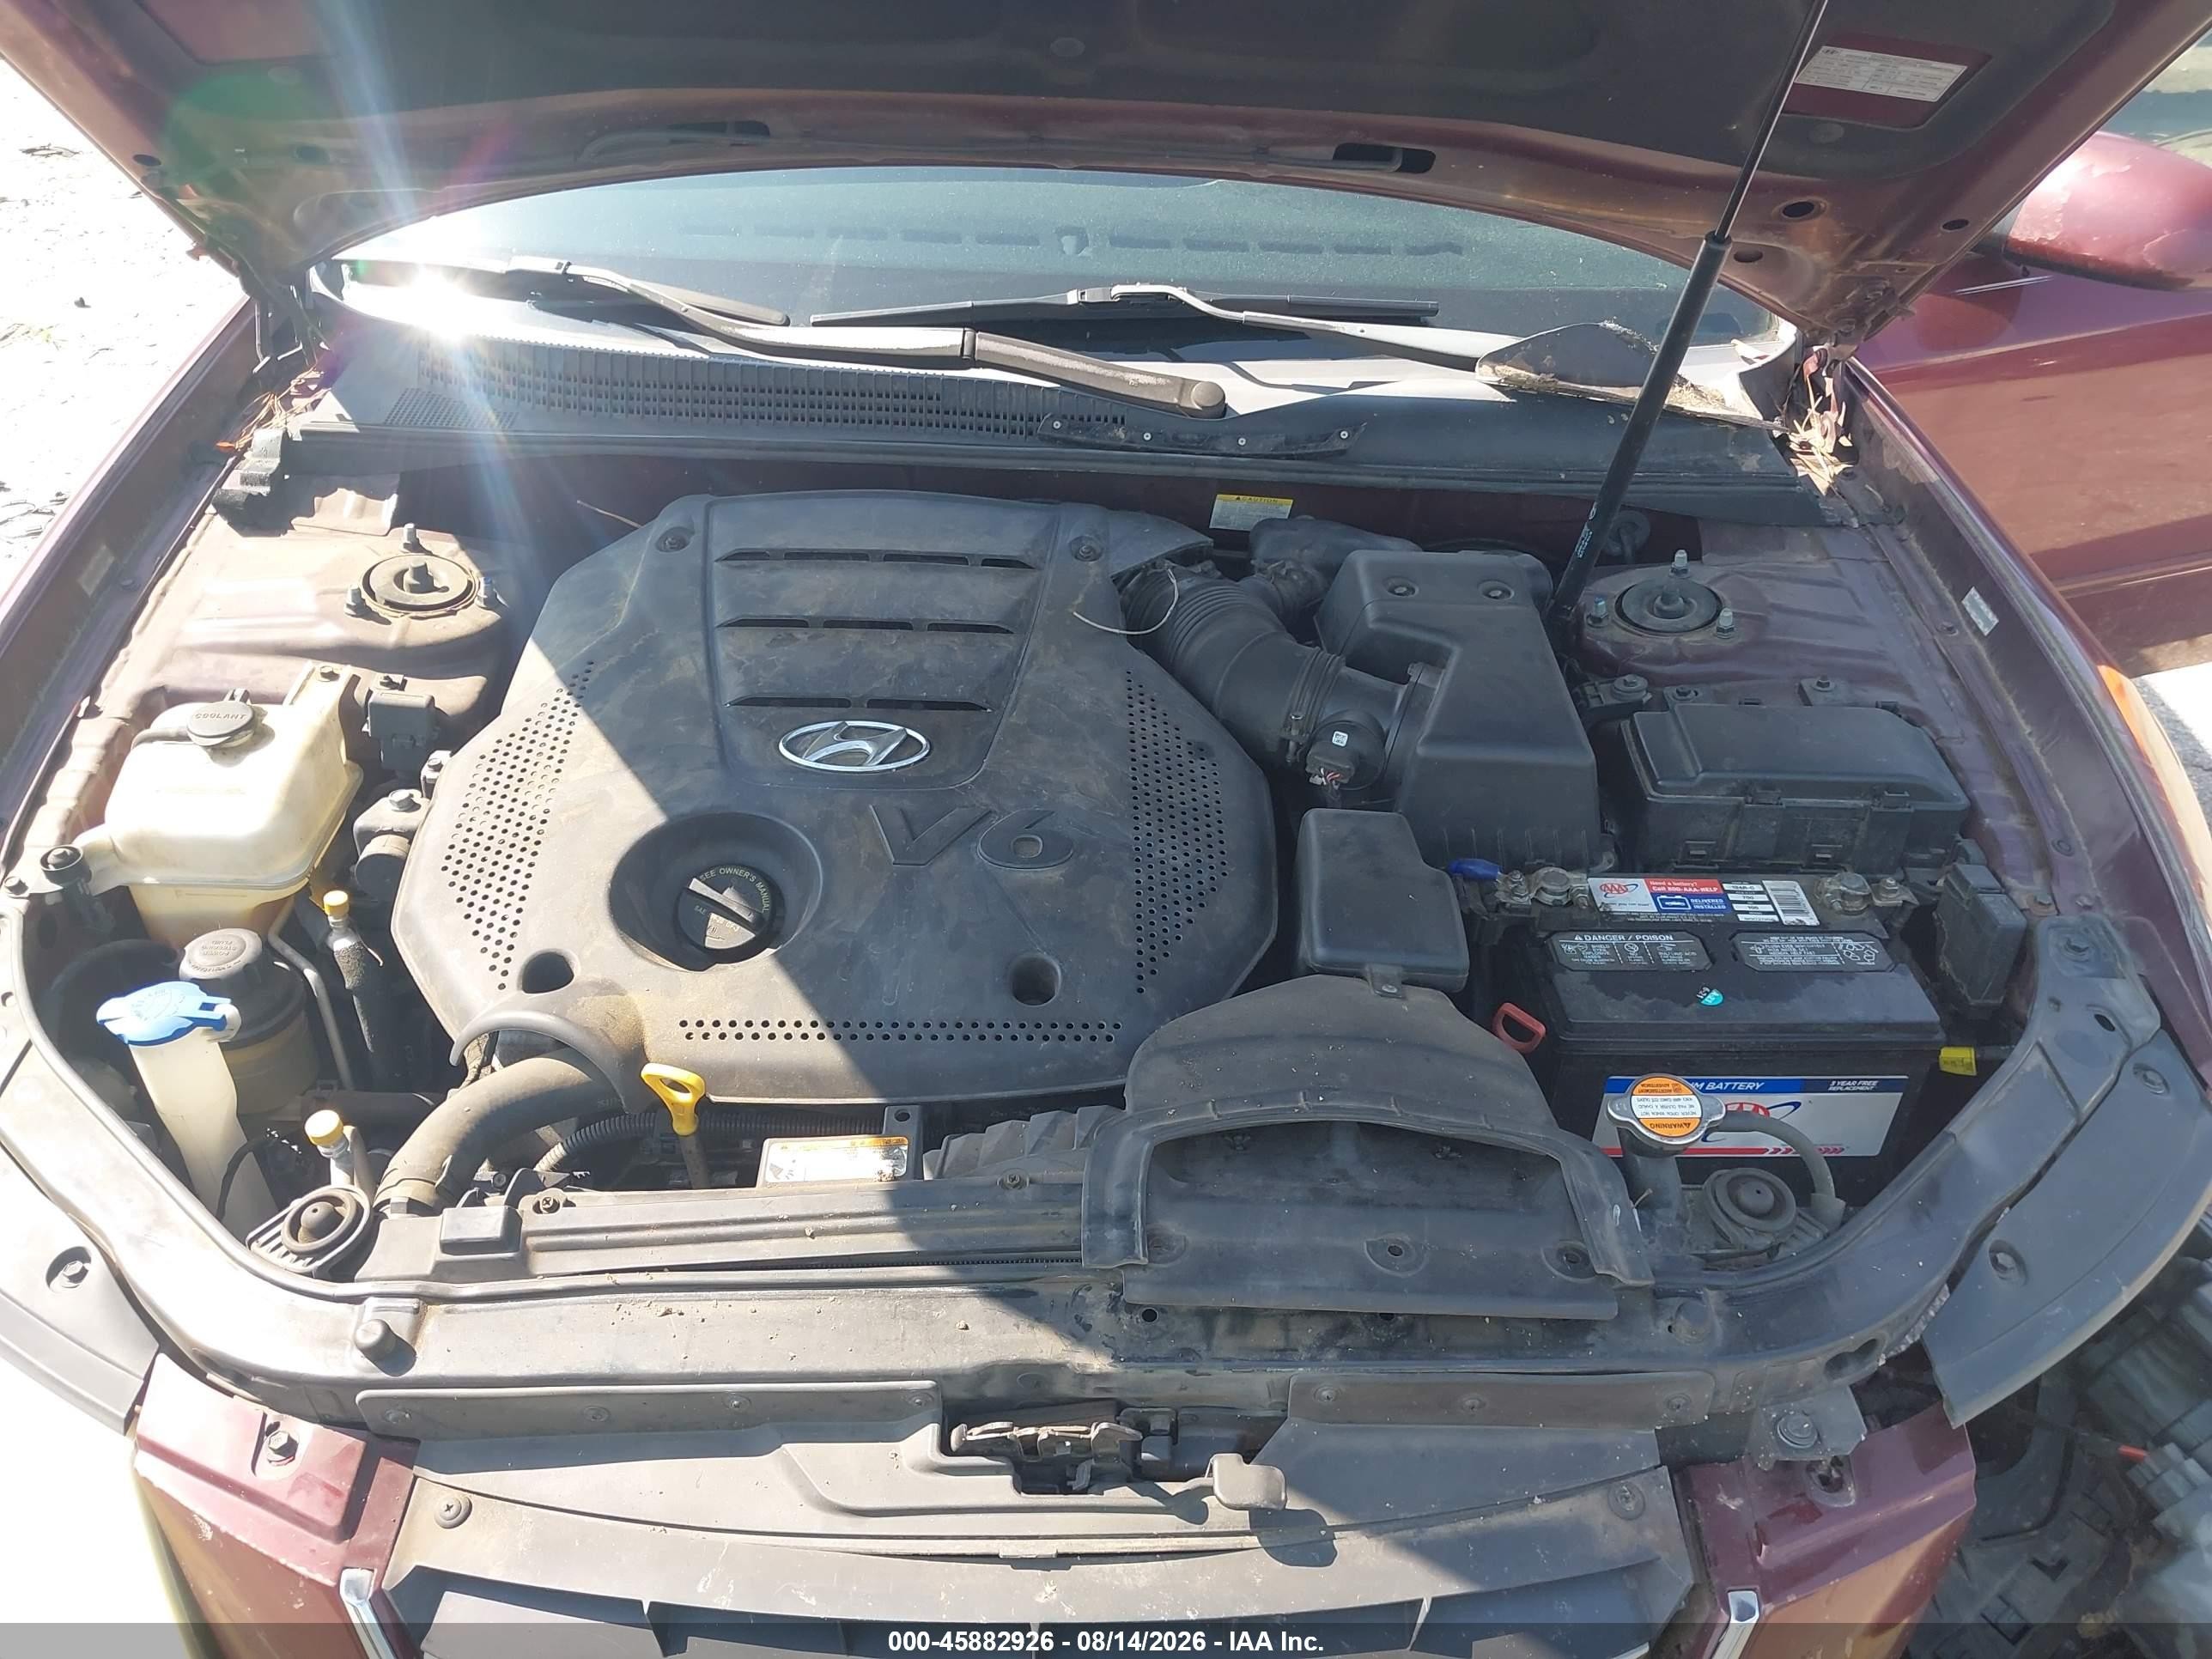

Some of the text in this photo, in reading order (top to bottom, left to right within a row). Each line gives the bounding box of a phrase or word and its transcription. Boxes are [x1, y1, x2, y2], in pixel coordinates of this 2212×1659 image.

[868, 804, 1074, 872] V6
[699, 867, 770, 913] SEE OWNER'S MANUAL
[1601, 883, 1628, 894] AAA
[1705, 1082, 1765, 1091] BATTERY
